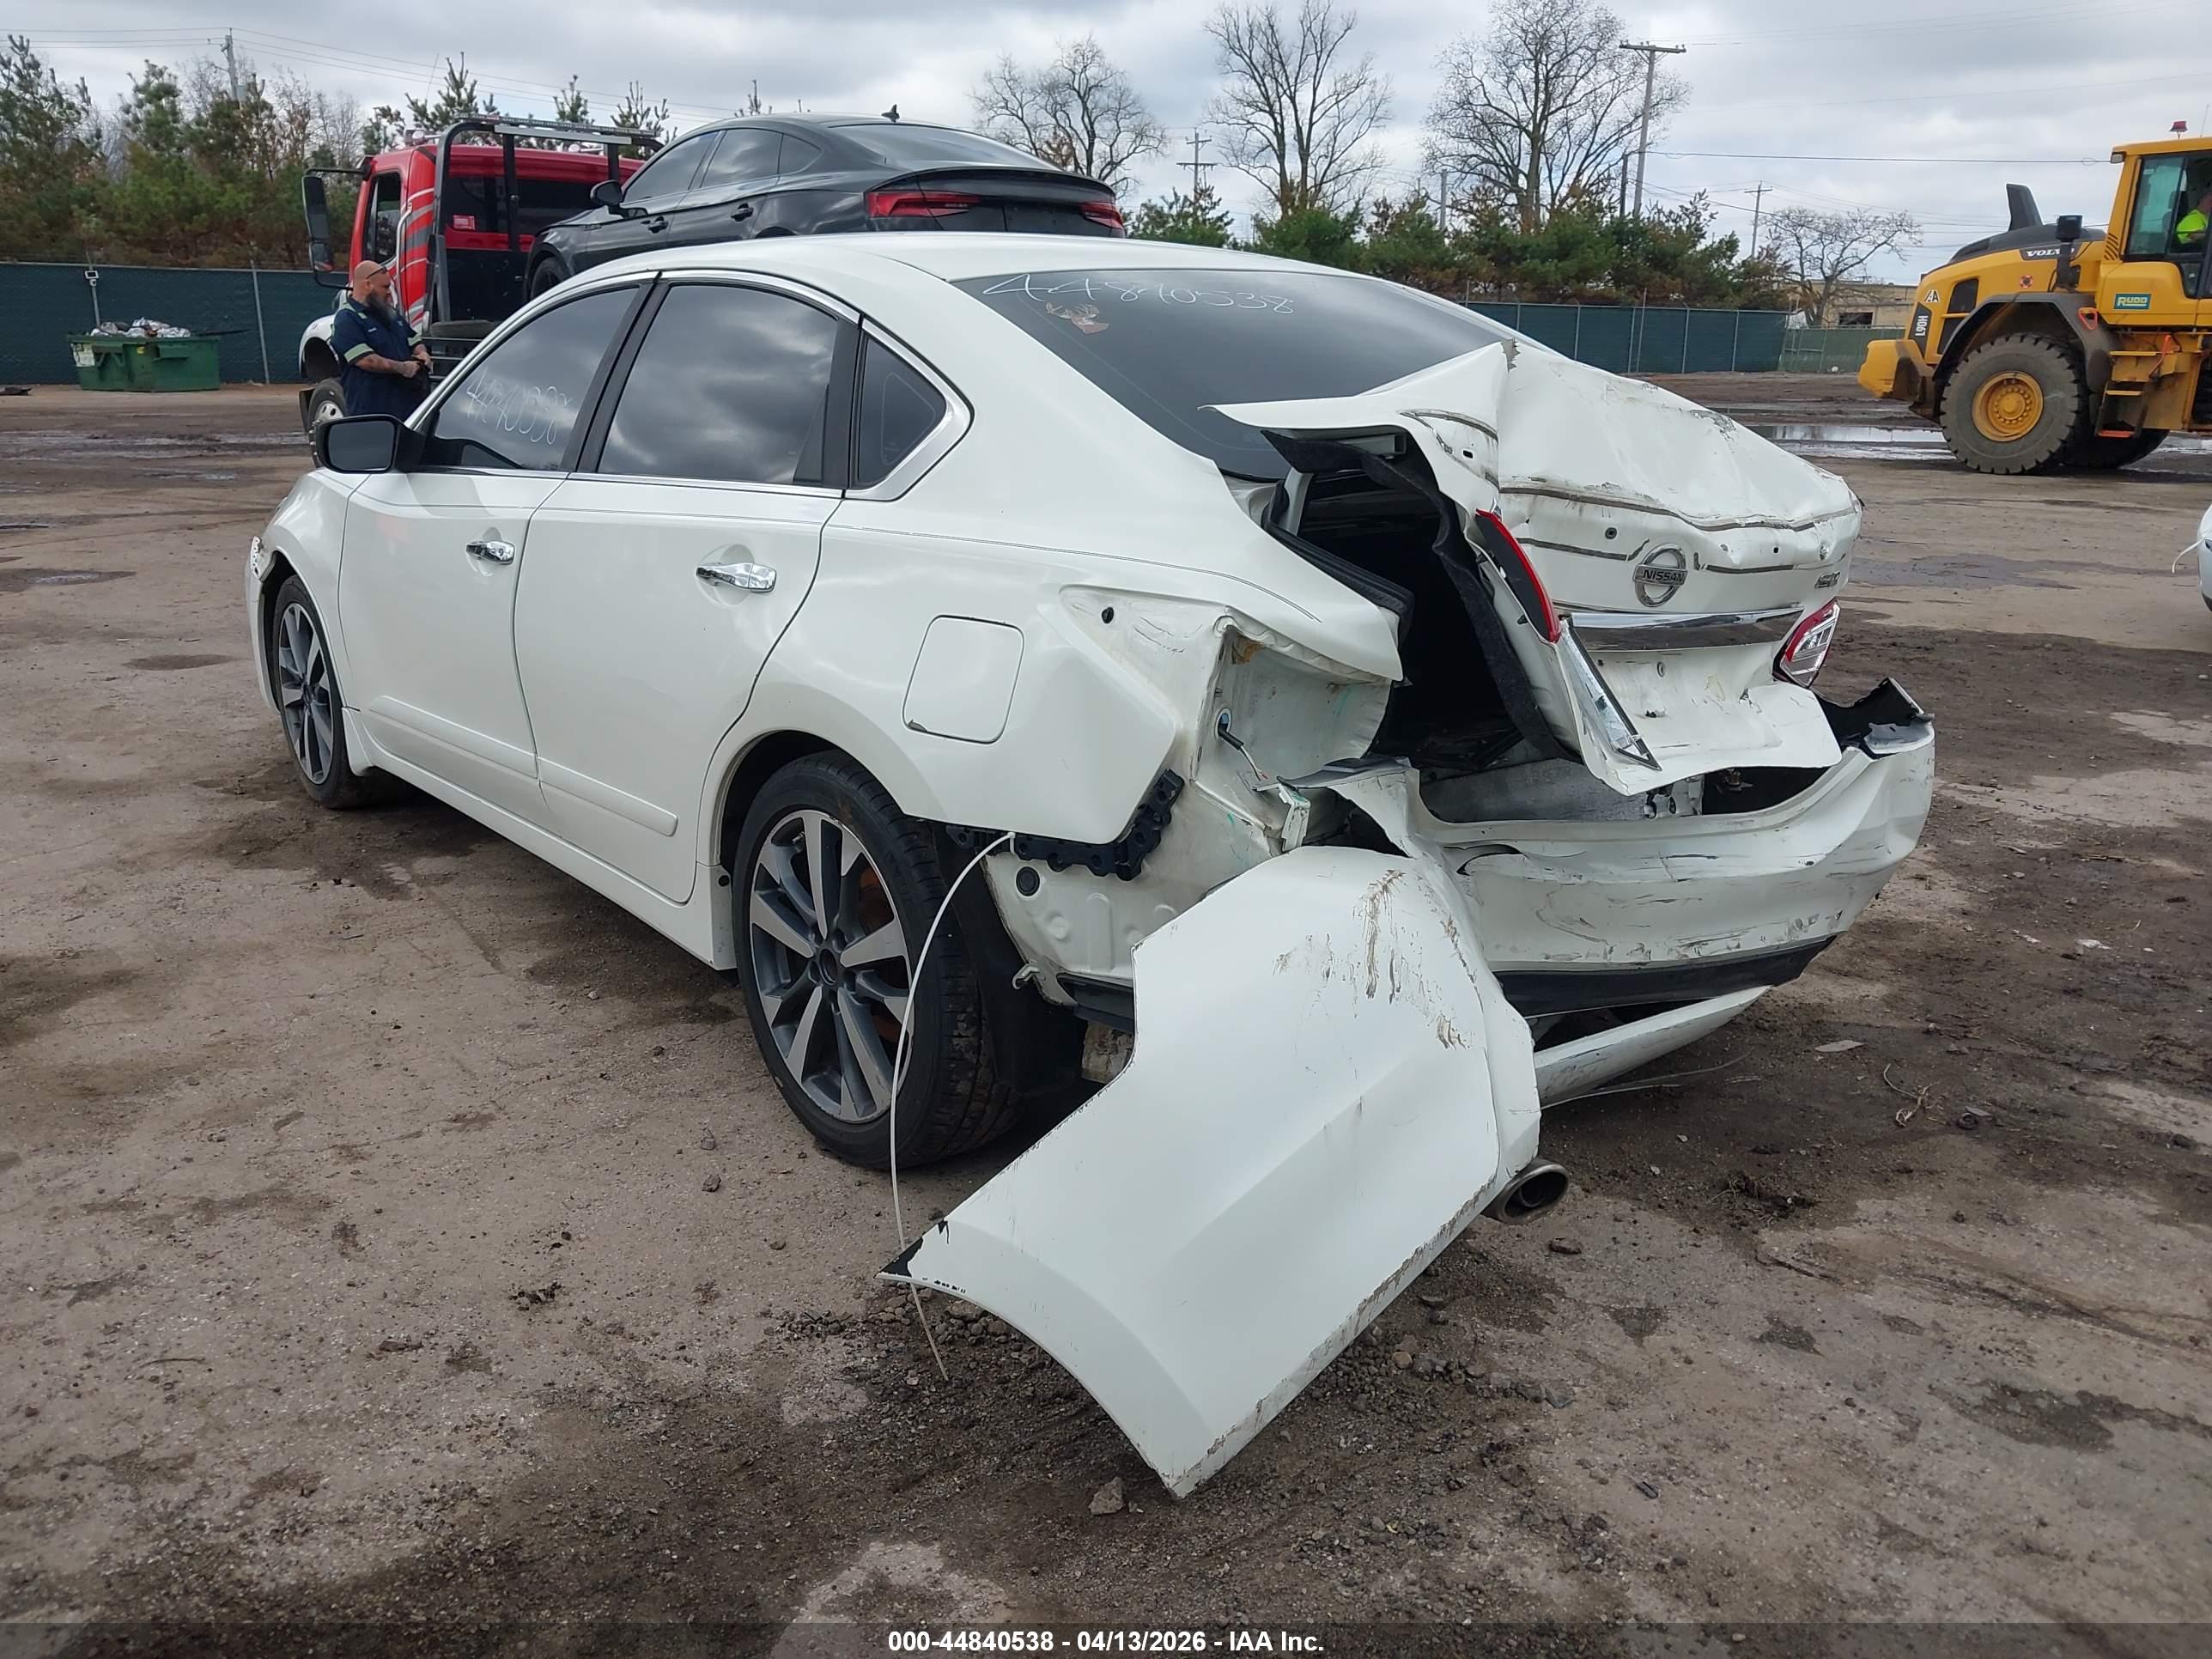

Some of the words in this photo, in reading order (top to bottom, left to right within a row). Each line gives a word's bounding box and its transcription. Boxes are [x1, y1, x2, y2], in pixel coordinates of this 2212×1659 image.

[2117, 296, 2148, 307] RUDD
[1914, 315, 1929, 337] L90H
[1643, 569, 1685, 582] NISSAN
